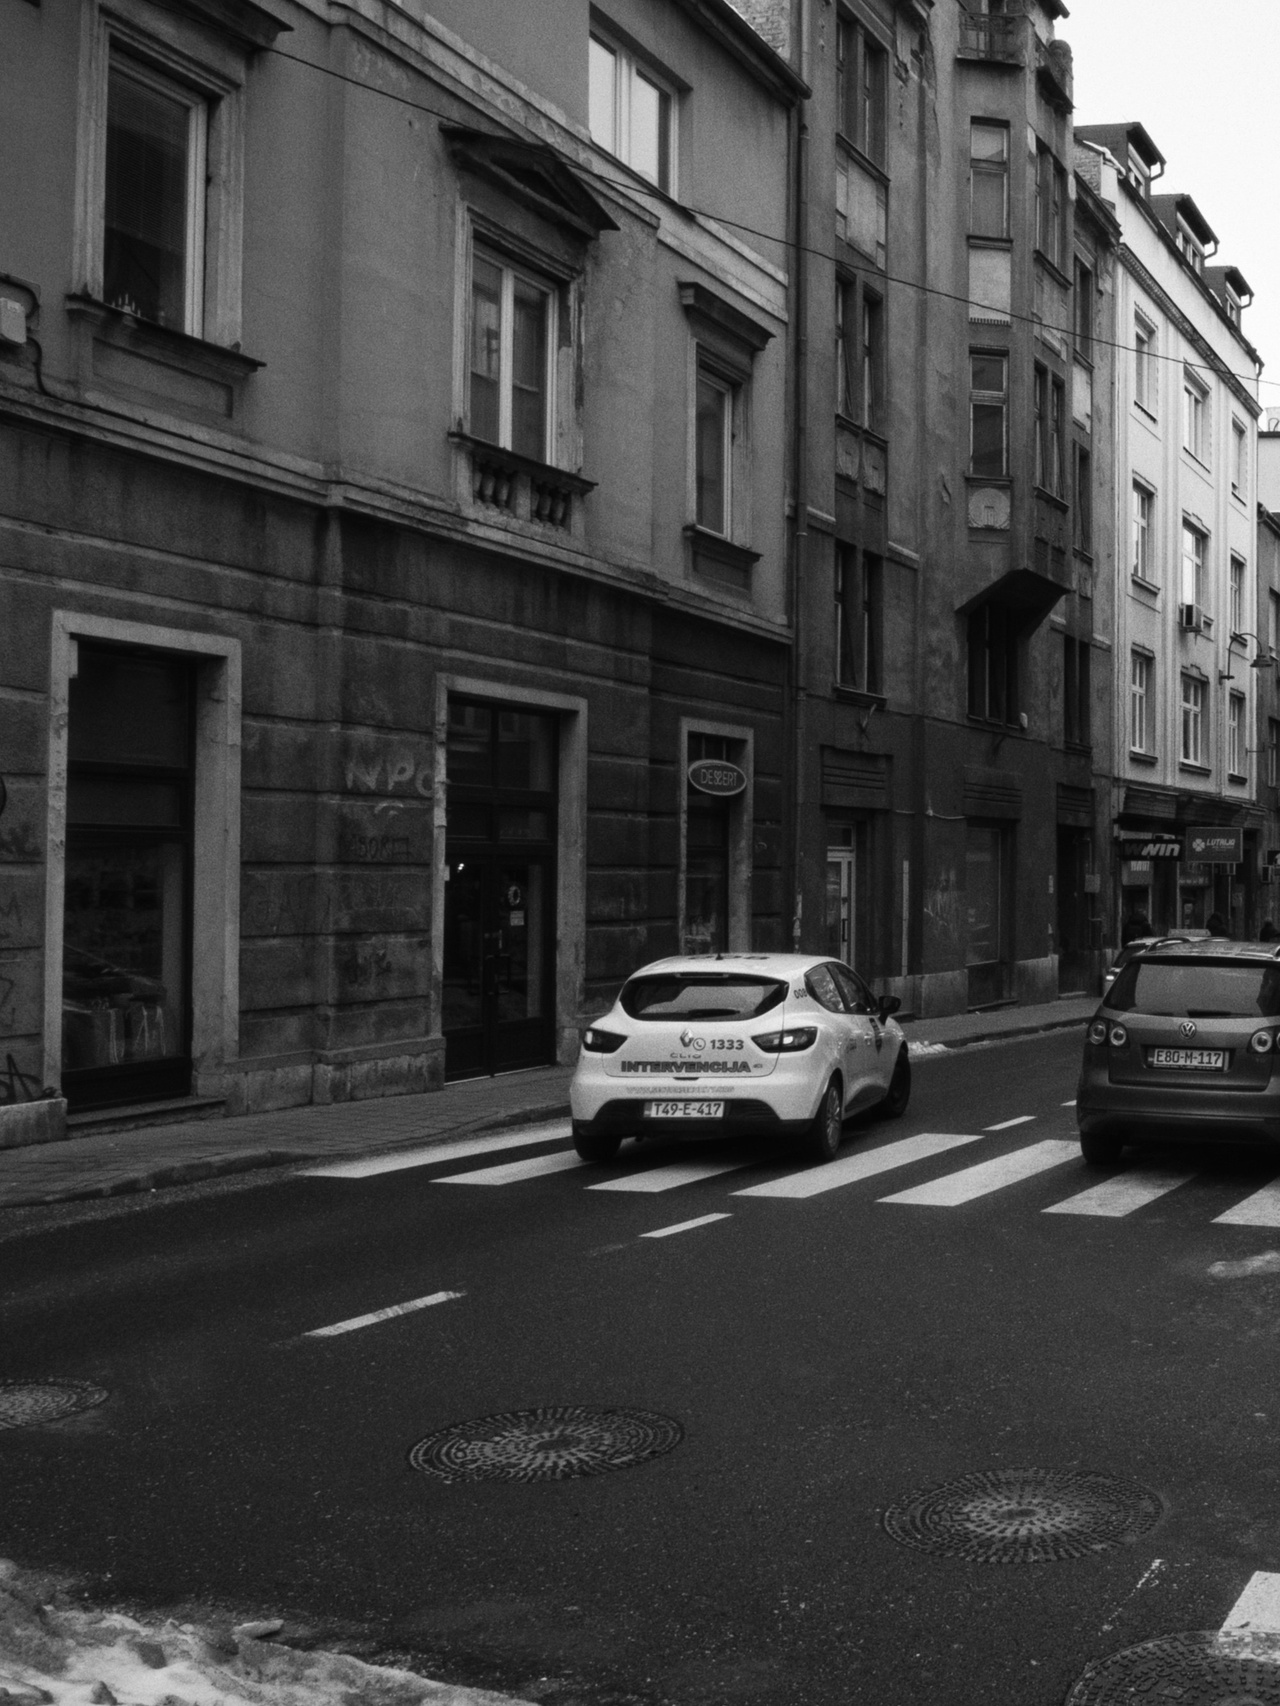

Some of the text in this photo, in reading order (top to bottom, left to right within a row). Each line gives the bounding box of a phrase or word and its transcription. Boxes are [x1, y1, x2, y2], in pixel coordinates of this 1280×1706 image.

[709, 1039, 745, 1051] 1333
[621, 1061, 751, 1073] INTERVENCIJA
[653, 1102, 722, 1117] T49-E-417
